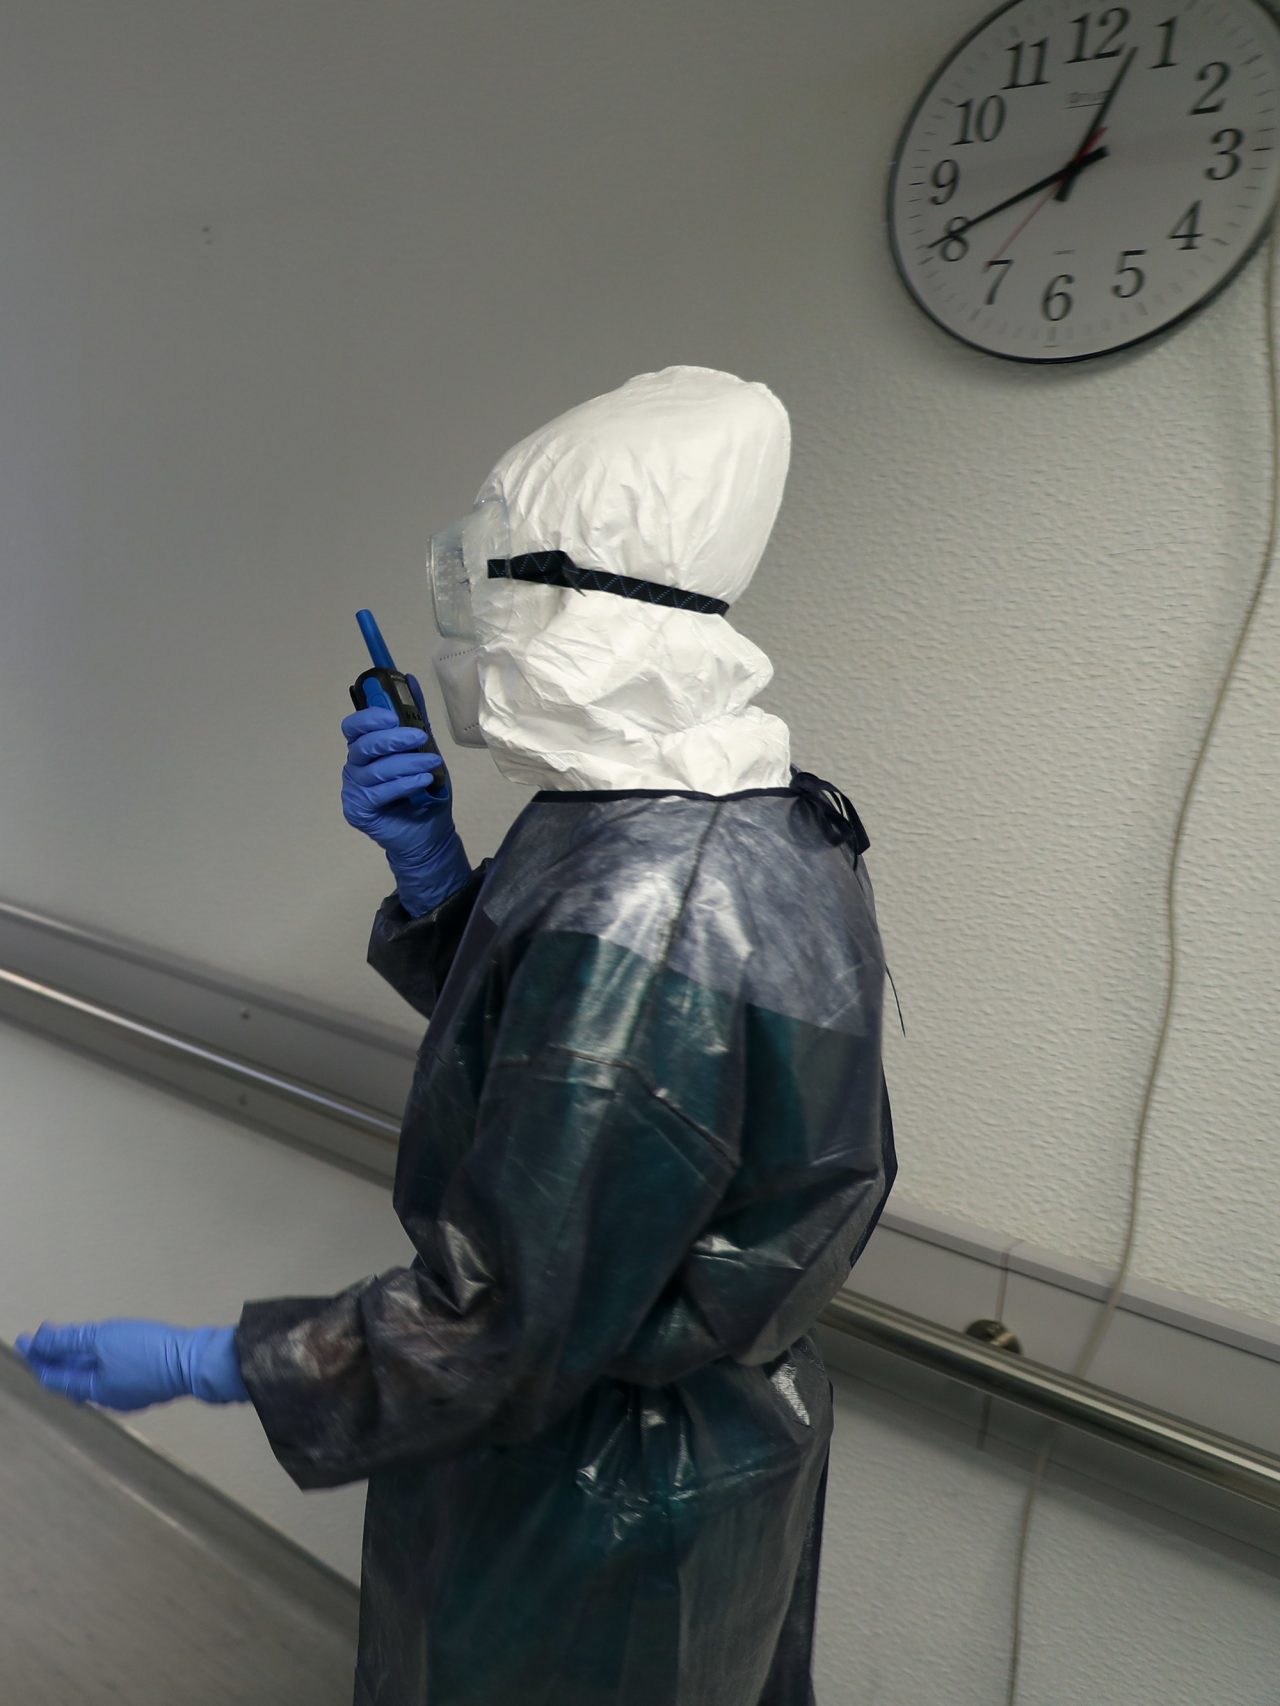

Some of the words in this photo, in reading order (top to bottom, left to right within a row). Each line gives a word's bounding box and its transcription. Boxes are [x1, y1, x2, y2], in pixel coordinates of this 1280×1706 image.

[1064, 7, 1130, 64] 12
[1150, 16, 1179, 69] 1
[1000, 37, 1050, 90] 11
[1189, 61, 1231, 115] 2
[951, 95, 1006, 145] 10
[1205, 128, 1244, 181] 3
[930, 159, 959, 205] 9
[940, 216, 969, 262] 8
[1168, 200, 1203, 250] 4
[985, 259, 1013, 305] 7
[1042, 274, 1074, 321] 6
[1112, 249, 1146, 298] 5
